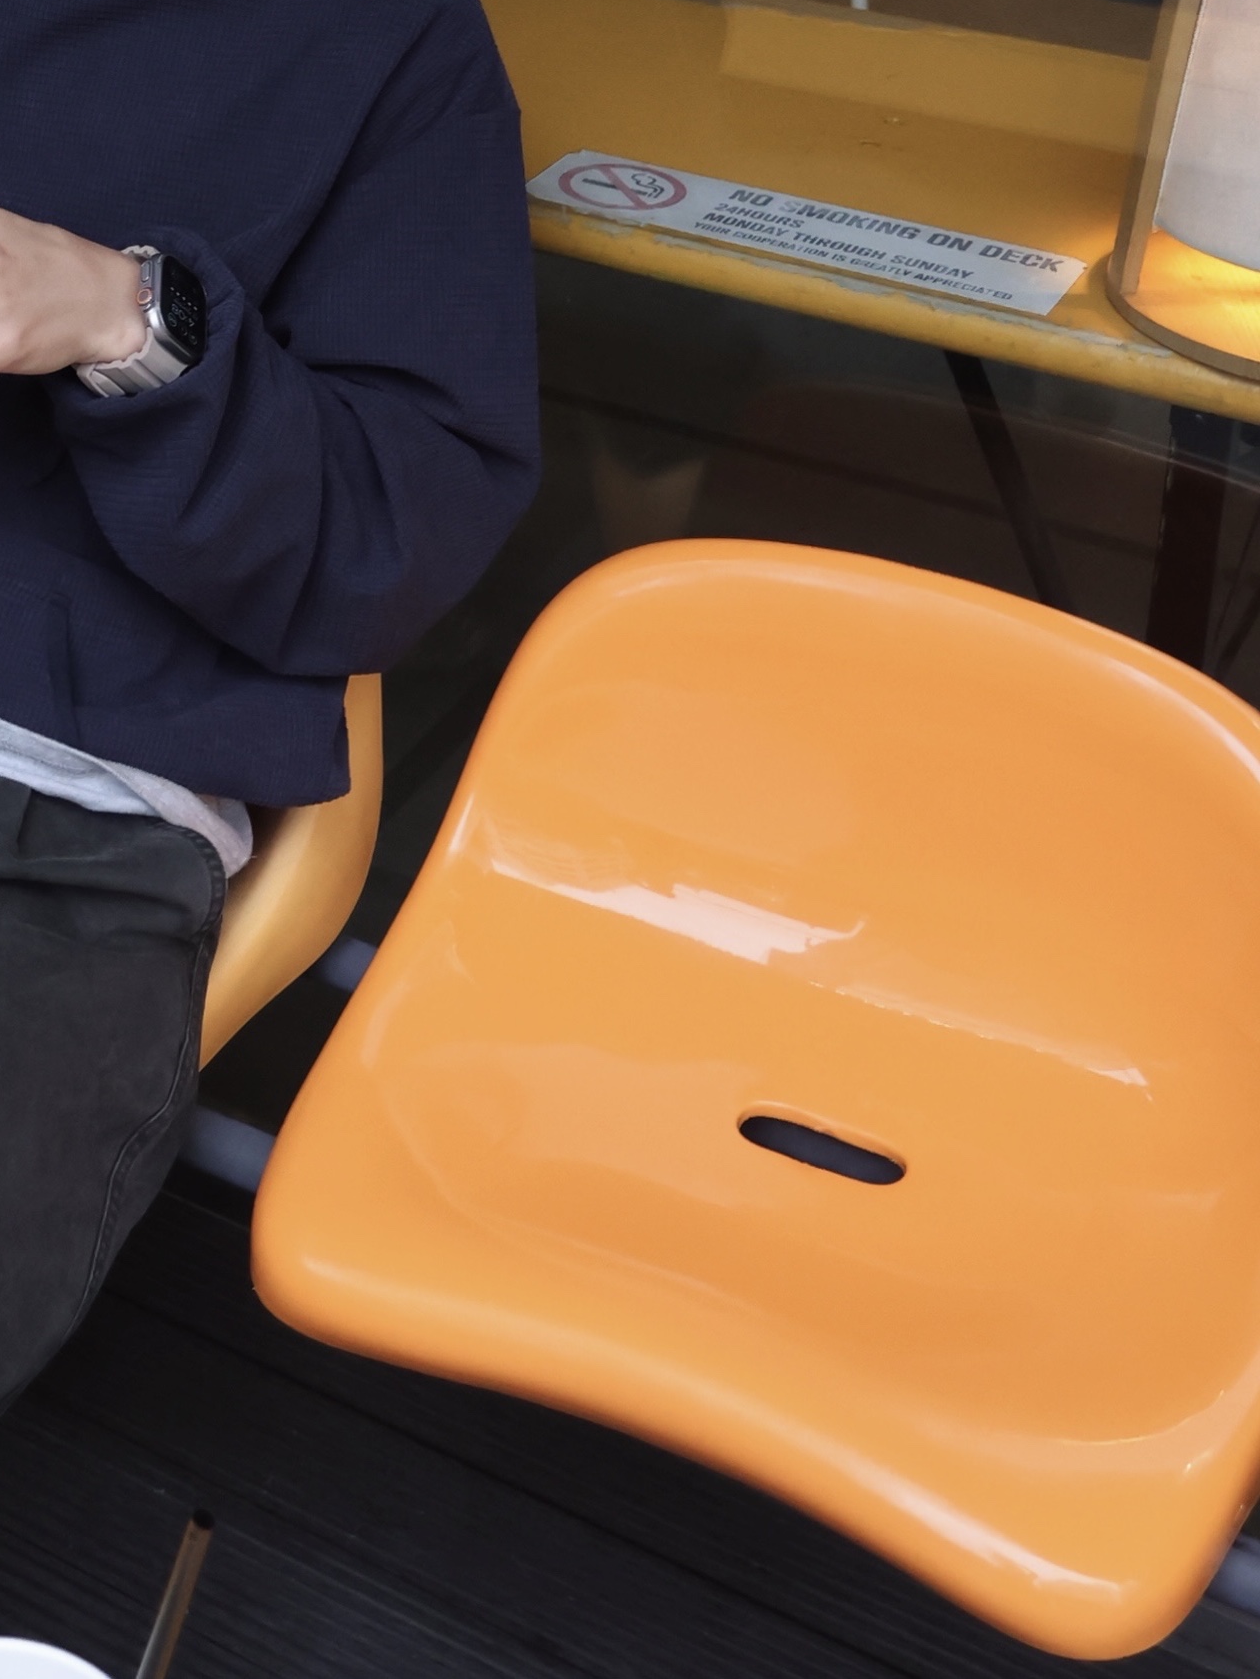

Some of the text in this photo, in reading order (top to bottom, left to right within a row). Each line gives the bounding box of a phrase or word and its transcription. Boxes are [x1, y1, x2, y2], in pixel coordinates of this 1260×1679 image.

[702, 212, 976, 279] MONDAY THROUGH SUNDAY
[714, 202, 805, 229] 24HOURS
[729, 189, 1065, 273] NO SMOKING ON DECK
[694, 221, 1013, 301] YOUR COOPERATION IS GREATLY APPRECIATED
